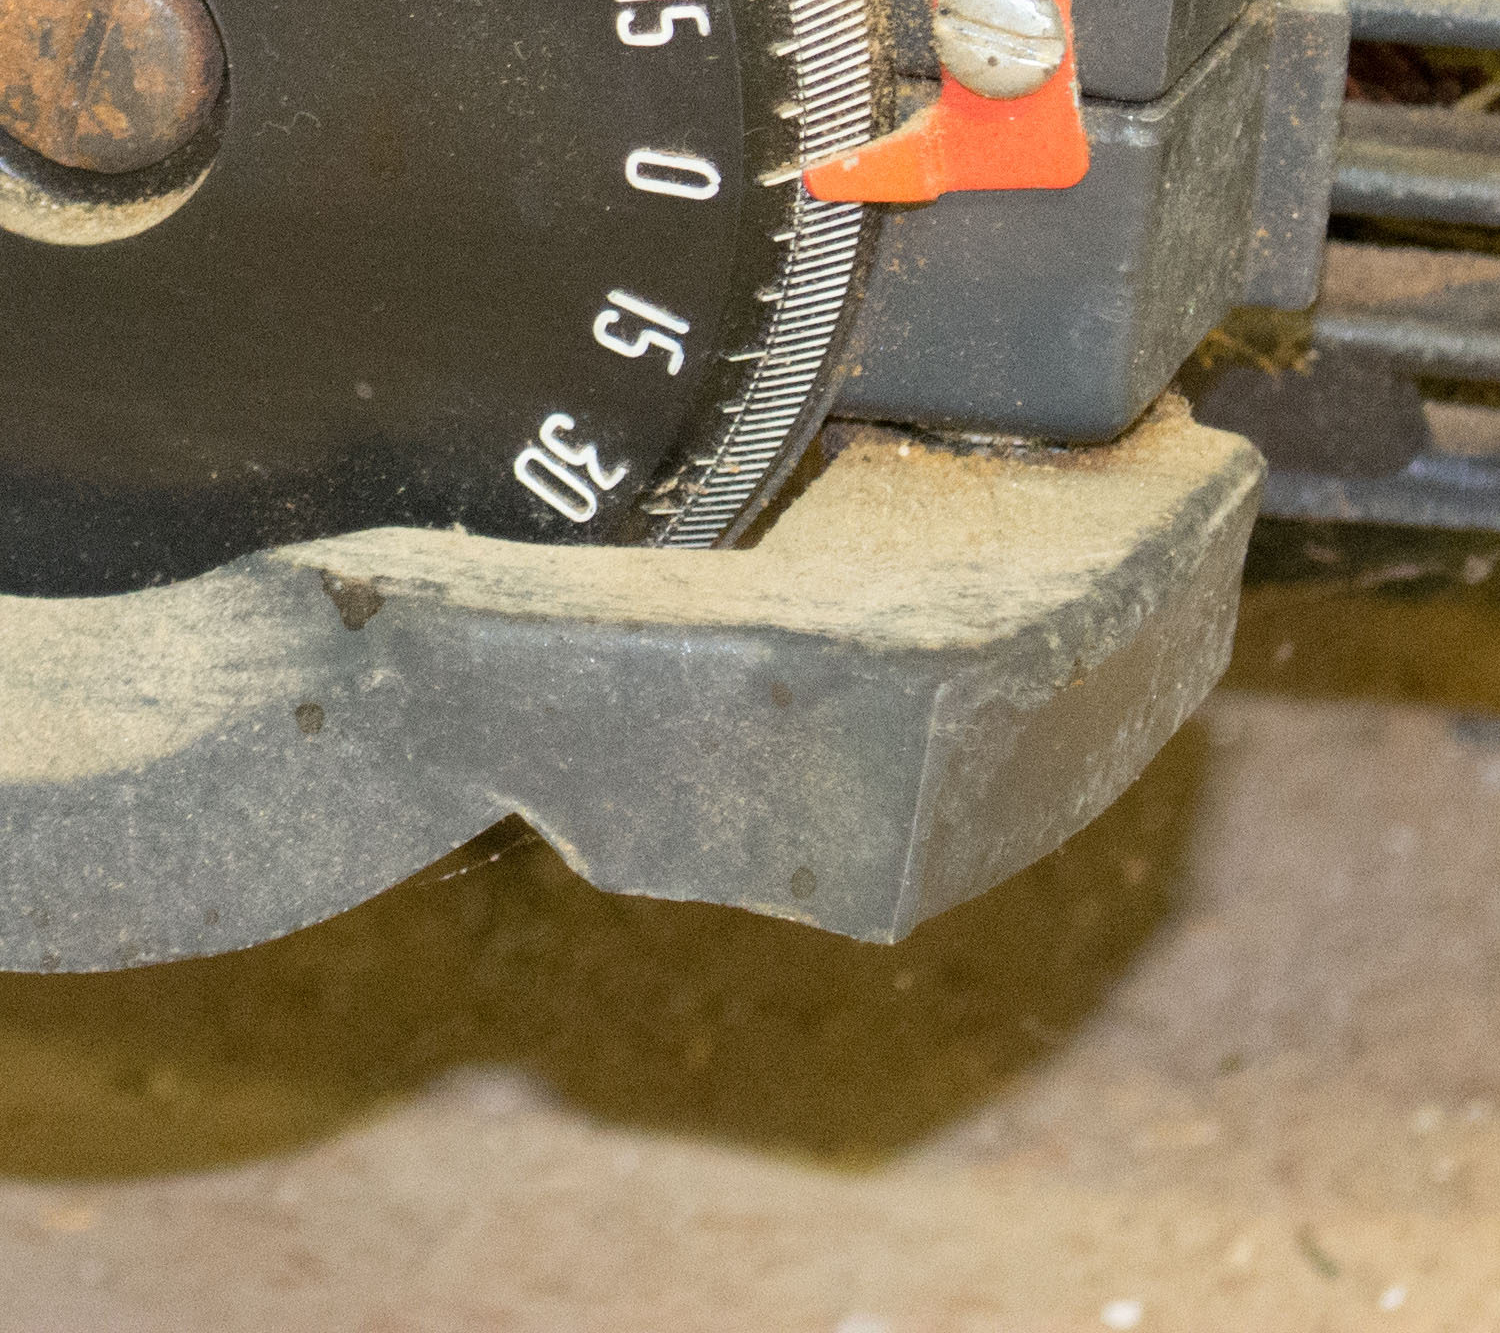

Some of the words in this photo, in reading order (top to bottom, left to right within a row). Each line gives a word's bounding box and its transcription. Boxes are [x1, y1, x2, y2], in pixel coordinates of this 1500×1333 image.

[625, 149, 721, 201] 0
[593, 290, 690, 375] 15
[513, 412, 630, 523] 30
